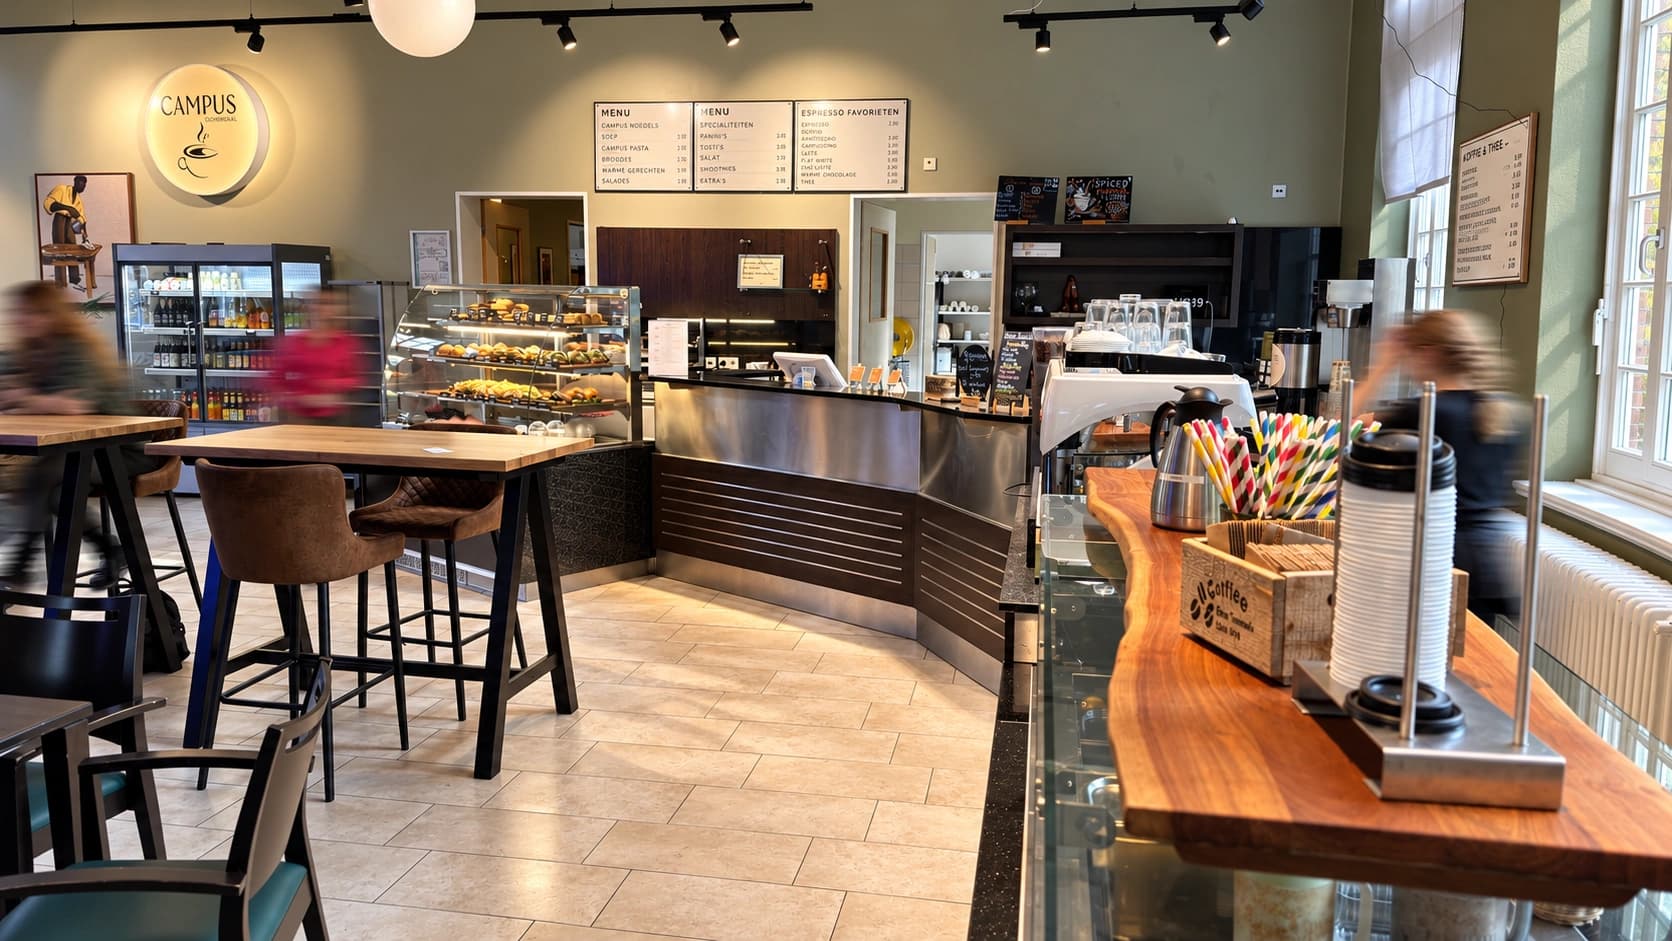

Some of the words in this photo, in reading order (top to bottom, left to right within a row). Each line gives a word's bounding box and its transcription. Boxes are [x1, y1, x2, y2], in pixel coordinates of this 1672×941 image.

[161, 94, 236, 116] CAMPUS
[601, 109, 630, 117] MENU
[701, 107, 730, 116] MENU
[801, 109, 845, 117] ESPRESSO
[847, 108, 899, 116] FAVORIETEN
[1488, 139, 1503, 153] THEE
